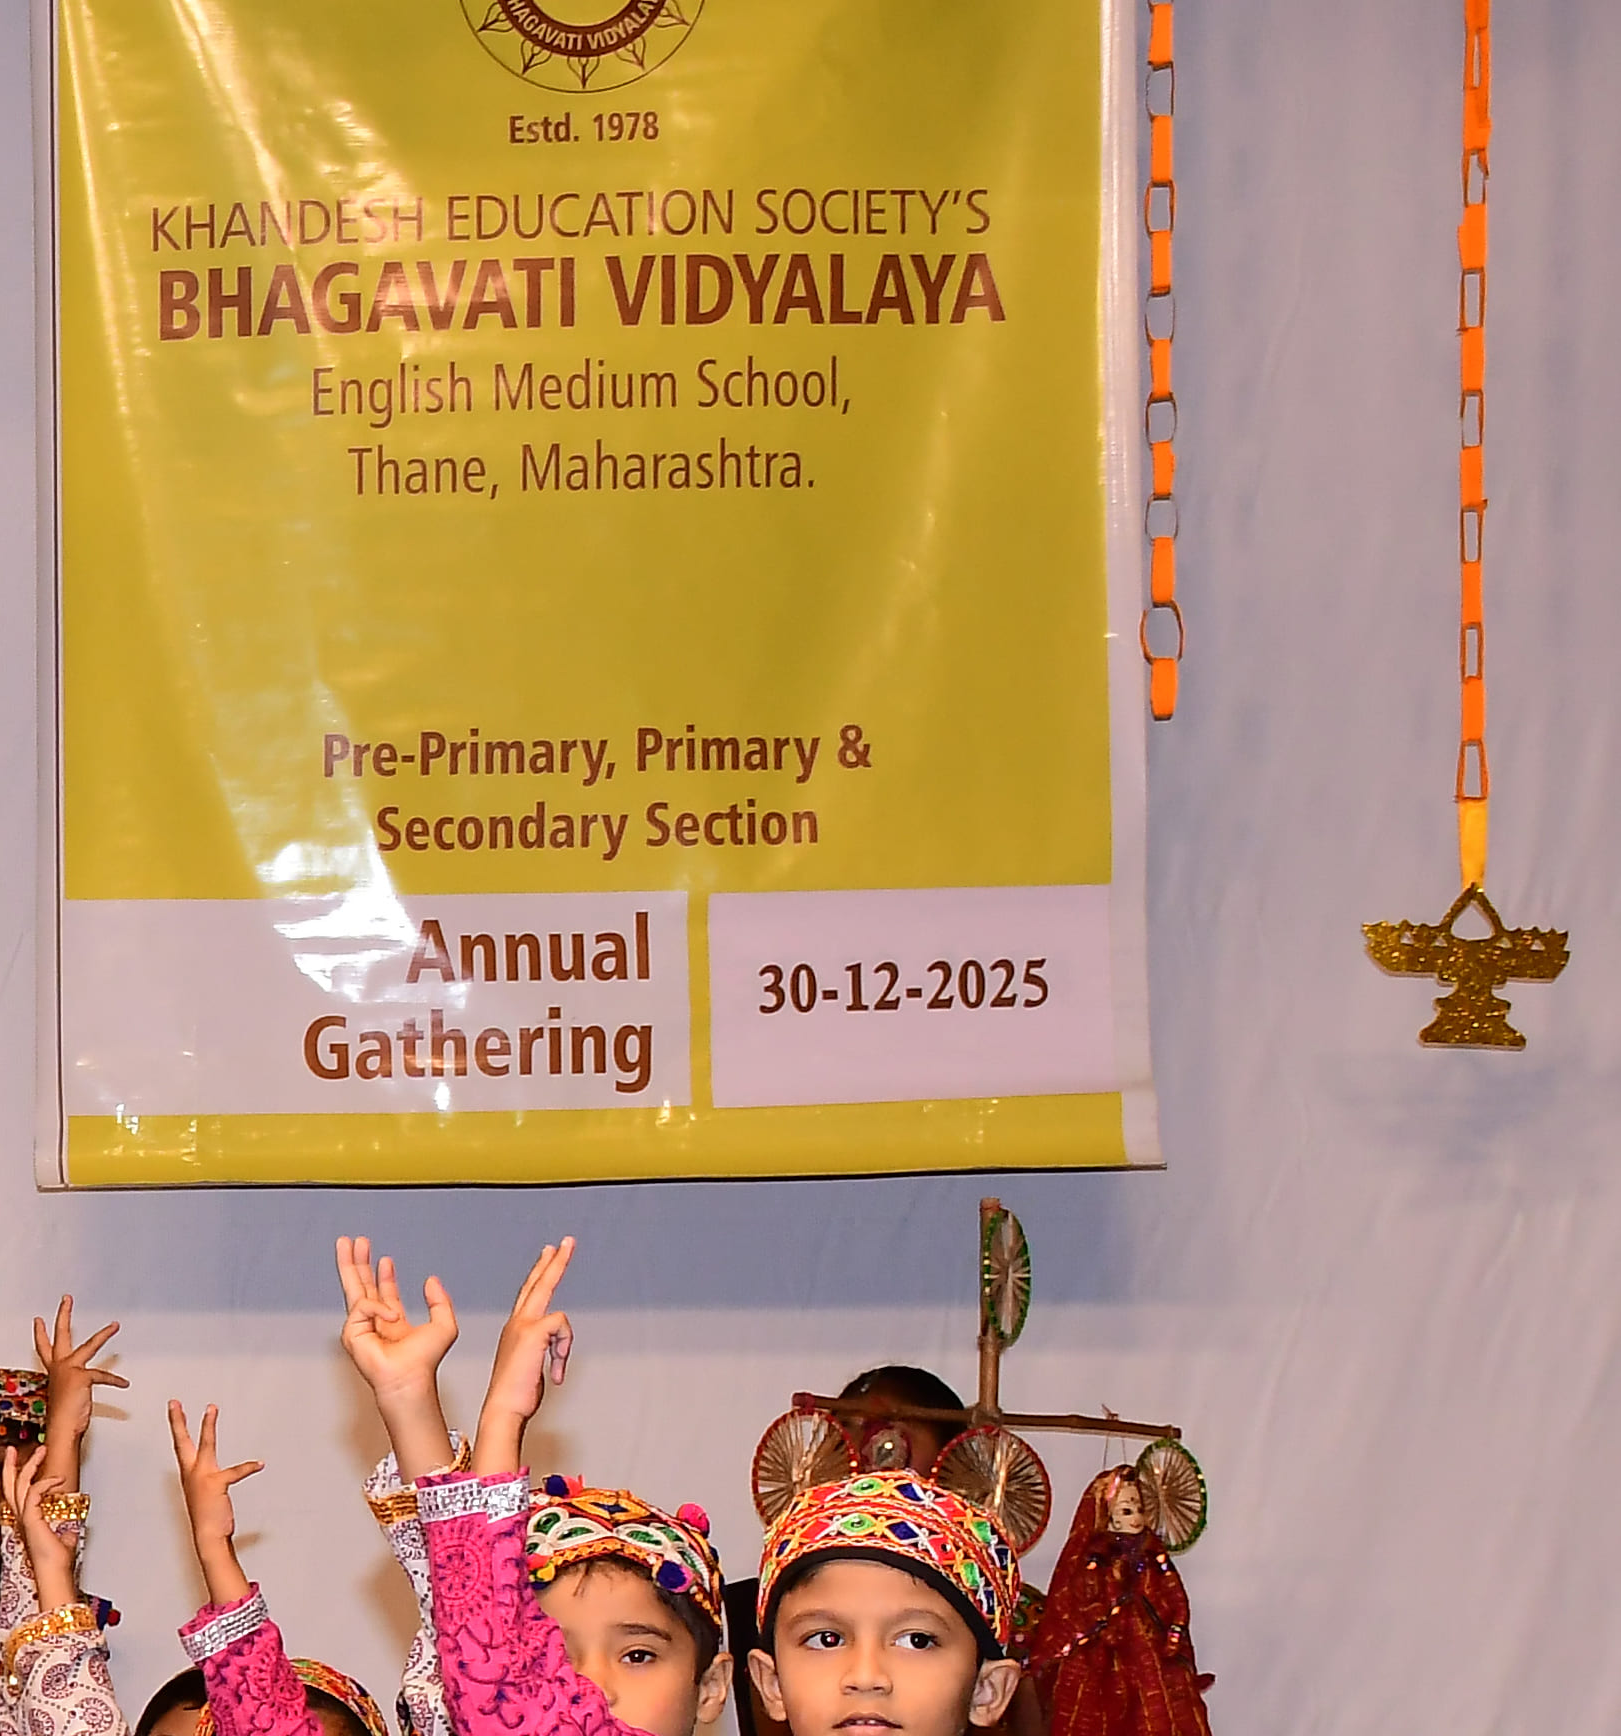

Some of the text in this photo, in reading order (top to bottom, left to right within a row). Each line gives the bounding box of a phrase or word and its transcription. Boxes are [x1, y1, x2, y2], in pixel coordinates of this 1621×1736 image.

[587, 0, 659, 49] VIDYALA
[509, 111, 659, 144] Estd. 1978
[151, 188, 992, 252] KHANDESH EDUCATION SOCIETY'S
[159, 252, 1007, 342] BHAGAVATI VIDYALAYA
[312, 355, 851, 429] English Medium School,
[347, 437, 816, 500] Thane, Maharashtra.
[322, 724, 872, 786] Pre-Primary, Primary &
[376, 798, 819, 861] Secondary Section
[405, 911, 651, 984] Annual
[758, 958, 1049, 1014] 30-12-2025
[303, 1006, 653, 1093] Gathering
